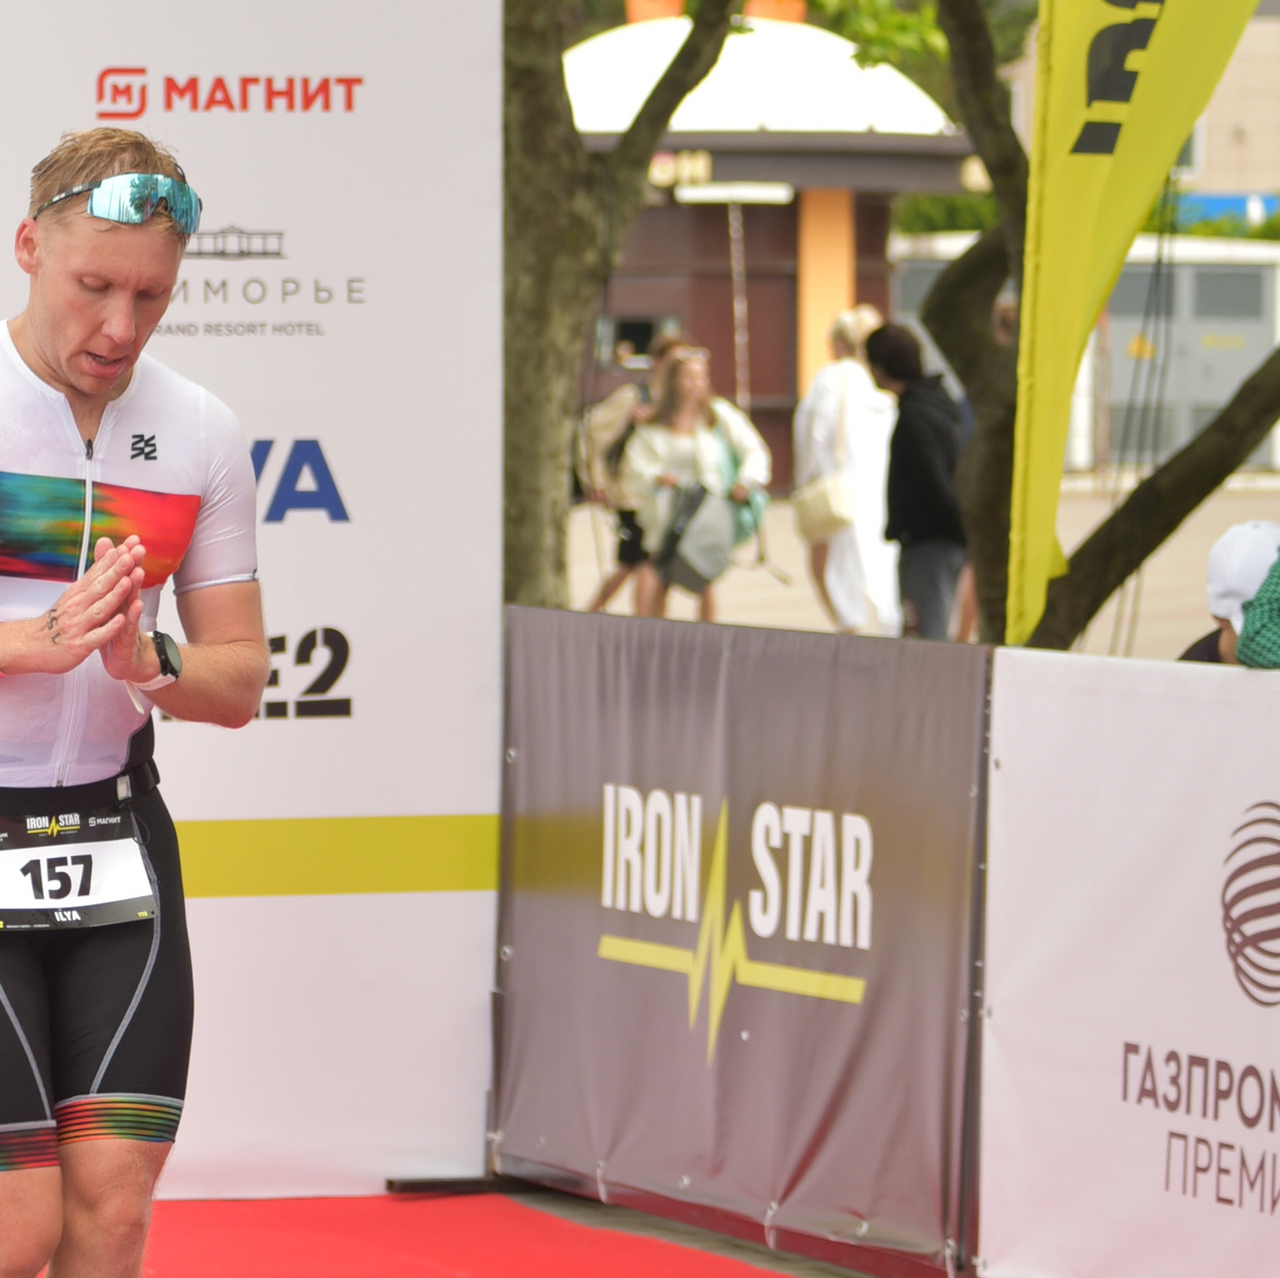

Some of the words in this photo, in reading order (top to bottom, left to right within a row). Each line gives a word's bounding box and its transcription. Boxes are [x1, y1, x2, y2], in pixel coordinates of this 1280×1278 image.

[163, 76, 363, 112] МАГНИТ
[271, 323, 325, 337] HOTEL
[26, 817, 49, 830] IRON
[58, 813, 81, 827] STAR
[20, 854, 93, 900] 157
[601, 784, 702, 922] IRON
[748, 801, 873, 950] STAR
[54, 910, 81, 922] ILYA
